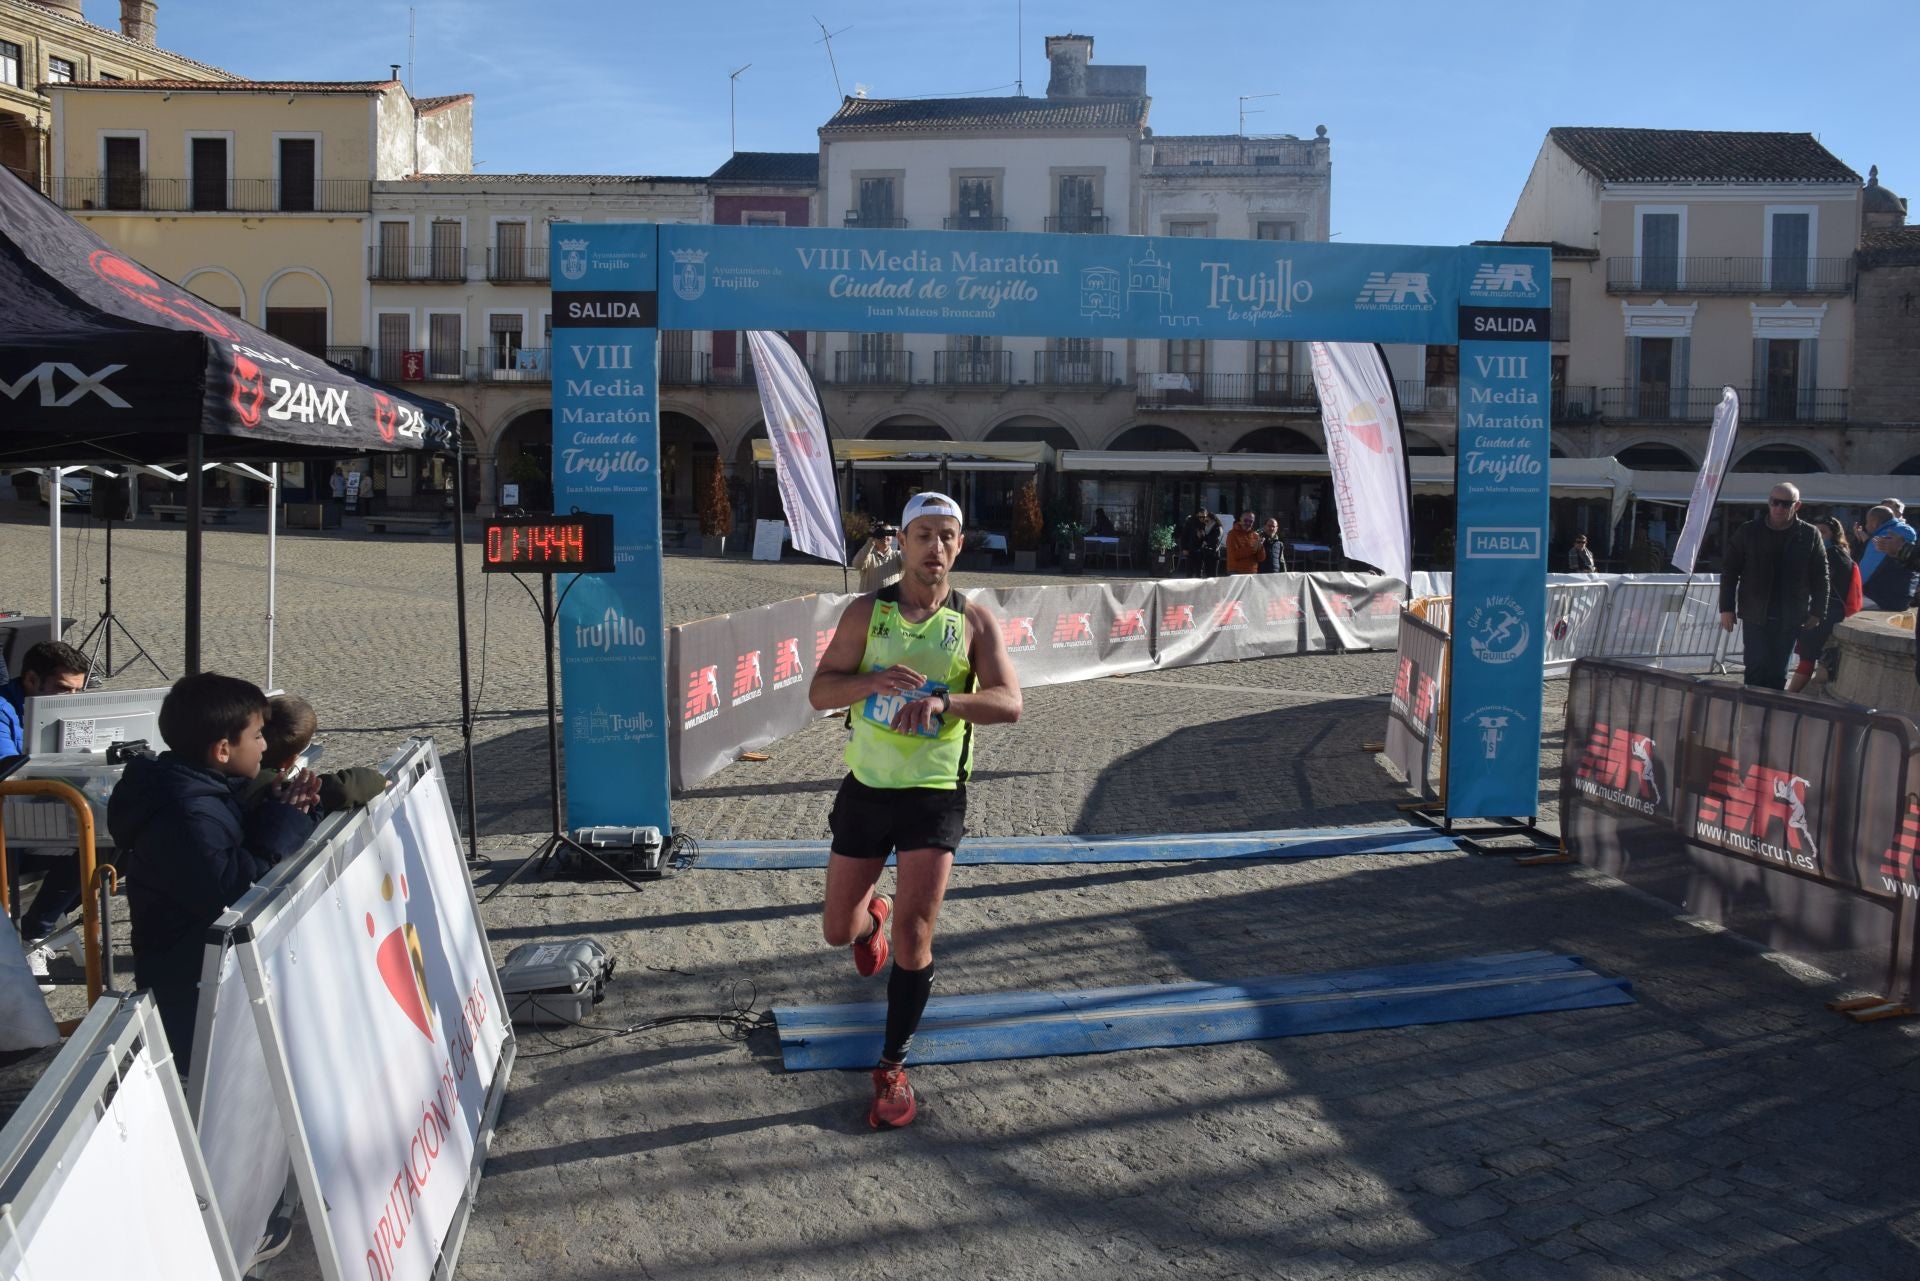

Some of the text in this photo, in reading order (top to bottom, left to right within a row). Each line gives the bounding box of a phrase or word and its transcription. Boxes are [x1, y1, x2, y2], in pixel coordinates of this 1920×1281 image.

[592, 252, 637, 260] Ayuntamiento
[796, 248, 1060, 274] VIII Media Maratón
[592, 260, 629, 271] Trujillo
[712, 266, 783, 277] Ayuntamiento de
[712, 276, 760, 291] Trujillo
[829, 274, 1039, 310] Ciudad de Trujillo
[1200, 258, 1313, 313] Trujillo
[1469, 290, 1537, 299] www.musicrun.es
[568, 302, 641, 319] SALIDA
[867, 306, 996, 319] Juan Mateos Broncano
[1227, 304, 1240, 321] te
[1354, 302, 1433, 312] www.musicrun.es
[1474, 316, 1537, 333] SALIDA
[570, 345, 633, 370] VIII
[1474, 355, 1529, 379] VIII
[566, 379, 645, 397] Media
[1470, 387, 1539, 404] Media
[267, 378, 353, 427] 24MX
[561, 407, 651, 424] Maratón
[1466, 413, 1544, 429] Maratón
[572, 431, 638, 445] Ciudad de
[1474, 435, 1532, 448] Ciudad de
[561, 448, 650, 482] Trujillo
[1465, 451, 1542, 483] Trujillo
[1477, 536, 1530, 550] HABLA
[614, 553, 635, 564] jillo
[609, 711, 653, 732] Trujillo
[1575, 776, 1655, 816] www.musicrun.es
[1696, 820, 1814, 871] www.musicrun.es
[366, 977, 487, 1281] DIPUTACIÓN DE CÁCERES
